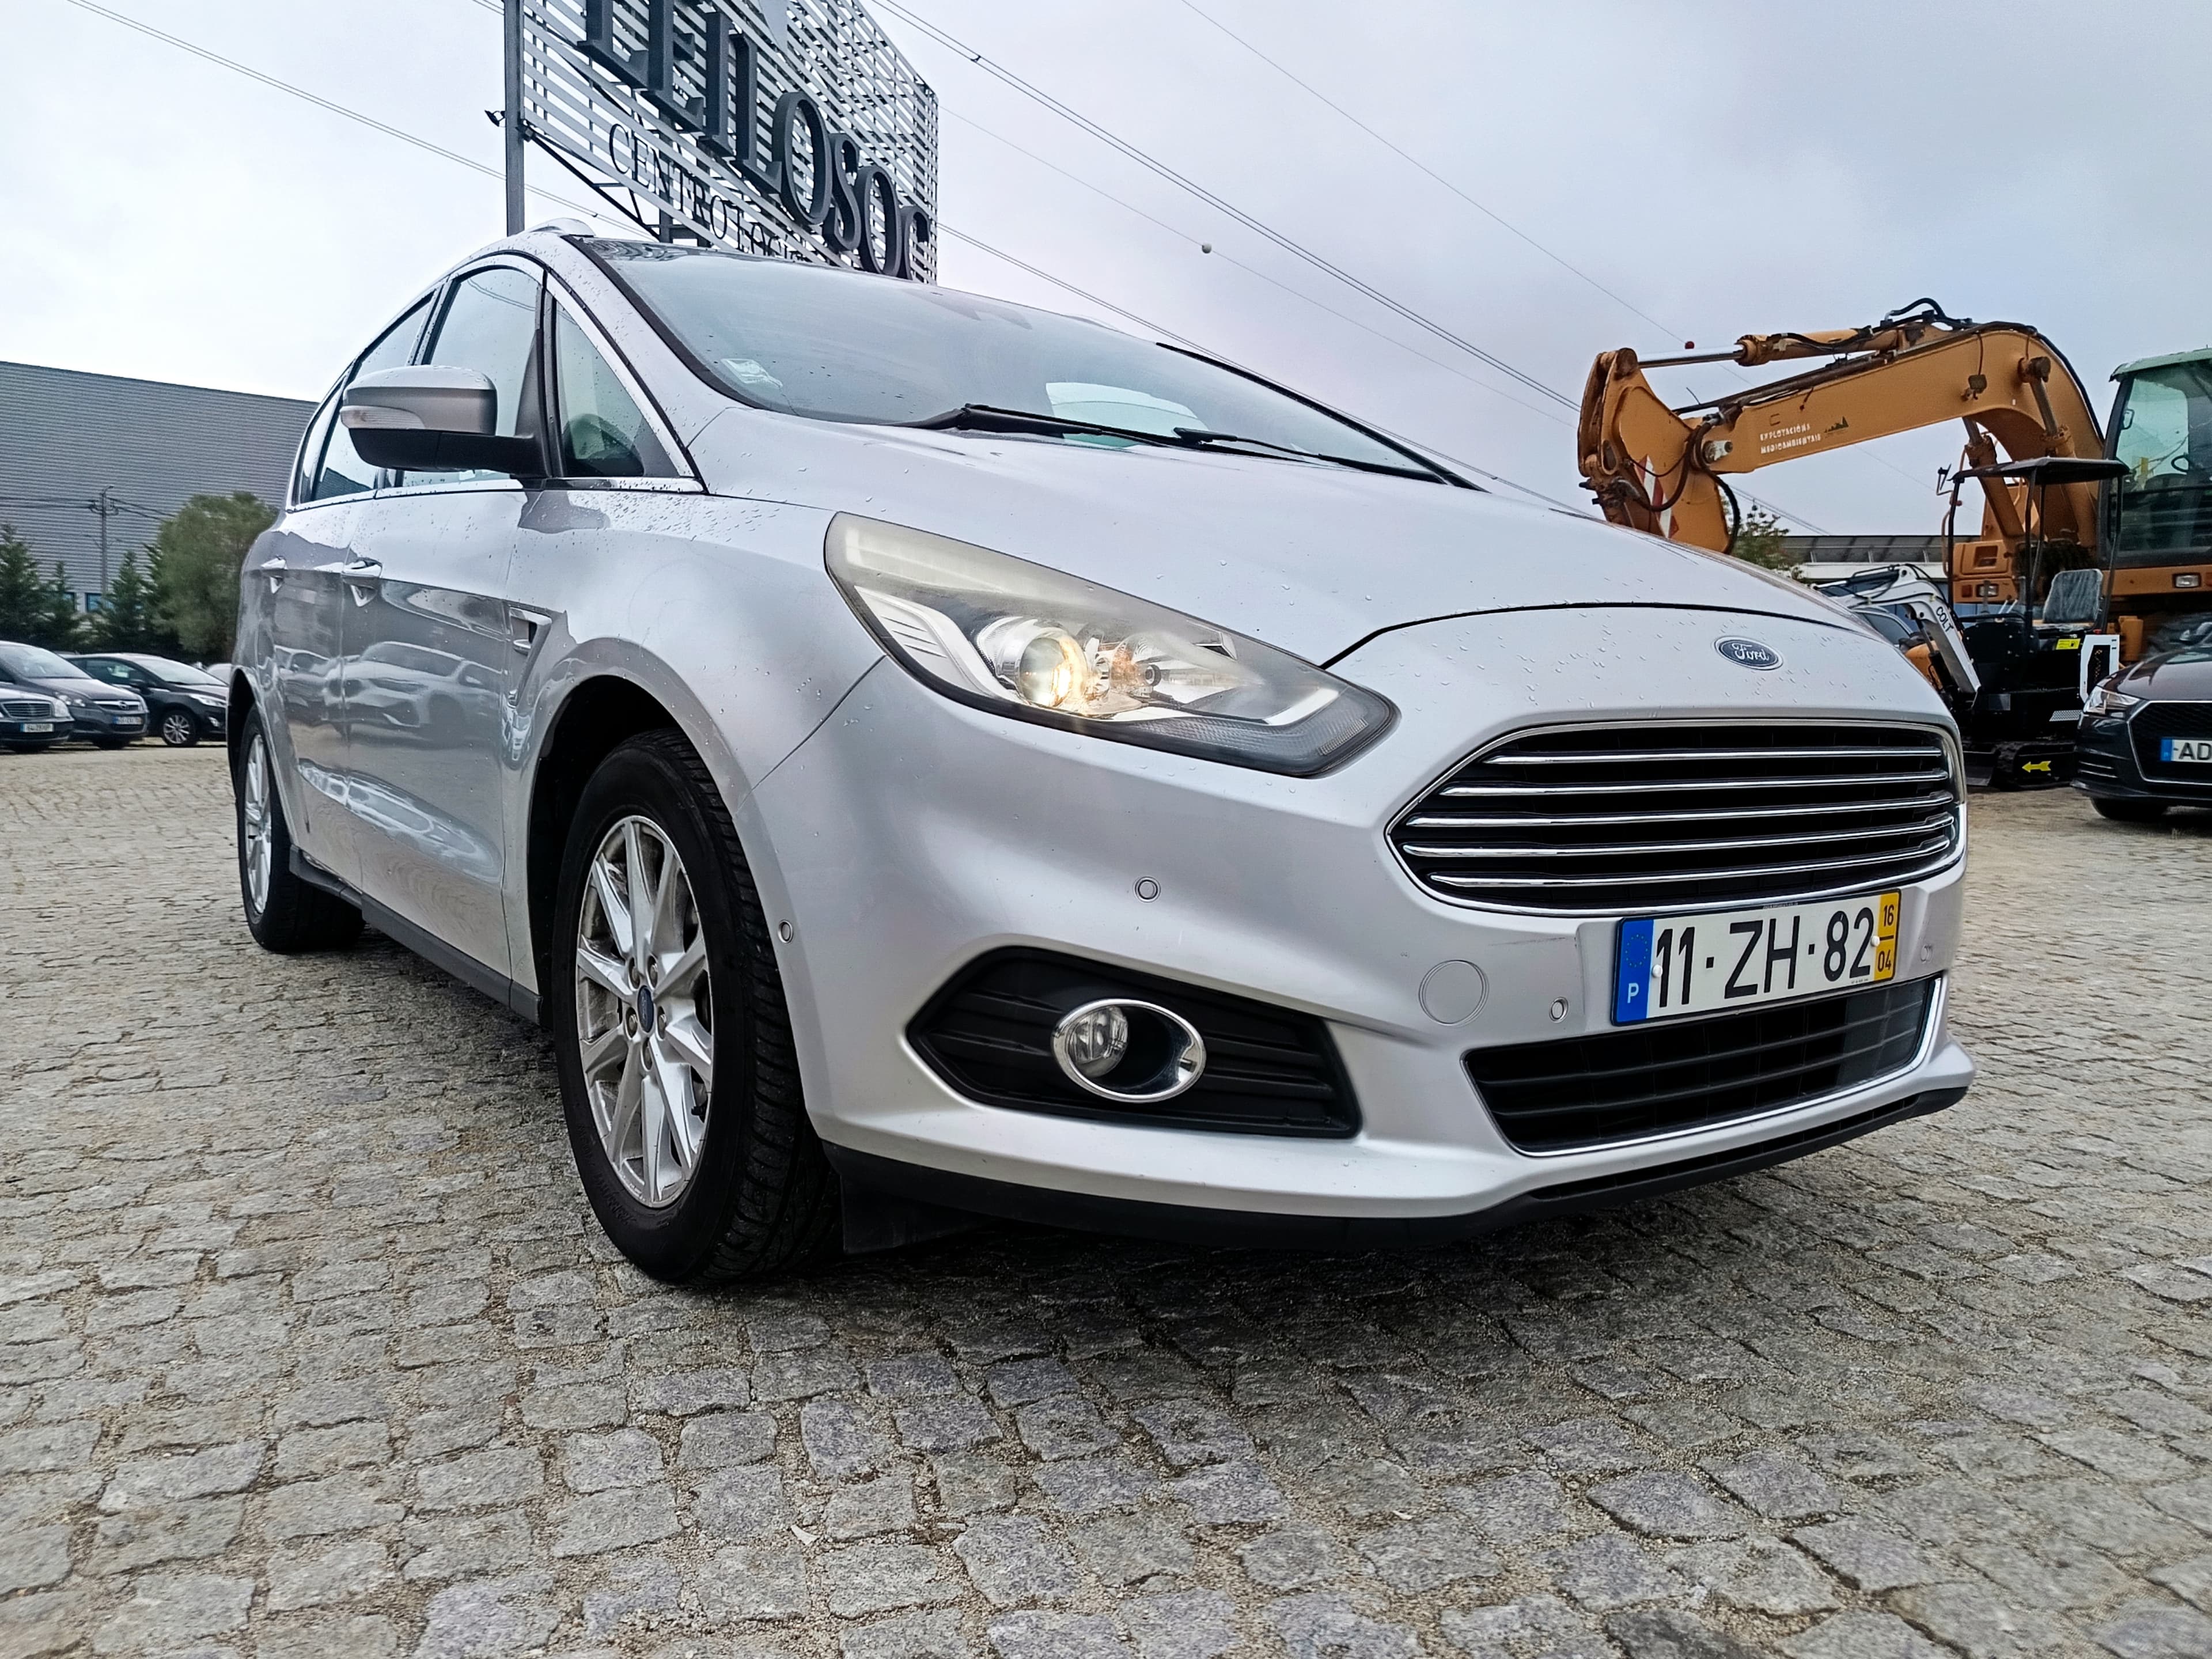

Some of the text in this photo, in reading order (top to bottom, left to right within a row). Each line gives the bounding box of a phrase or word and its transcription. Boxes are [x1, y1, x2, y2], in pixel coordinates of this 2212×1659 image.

[609, 123, 728, 240] CENTRO
[1936, 606, 1954, 632] COLT
[1731, 643, 1770, 662] Ford
[1883, 904, 1895, 927] 16
[1878, 949, 1892, 973] 04
[1627, 982, 1639, 1004] P
